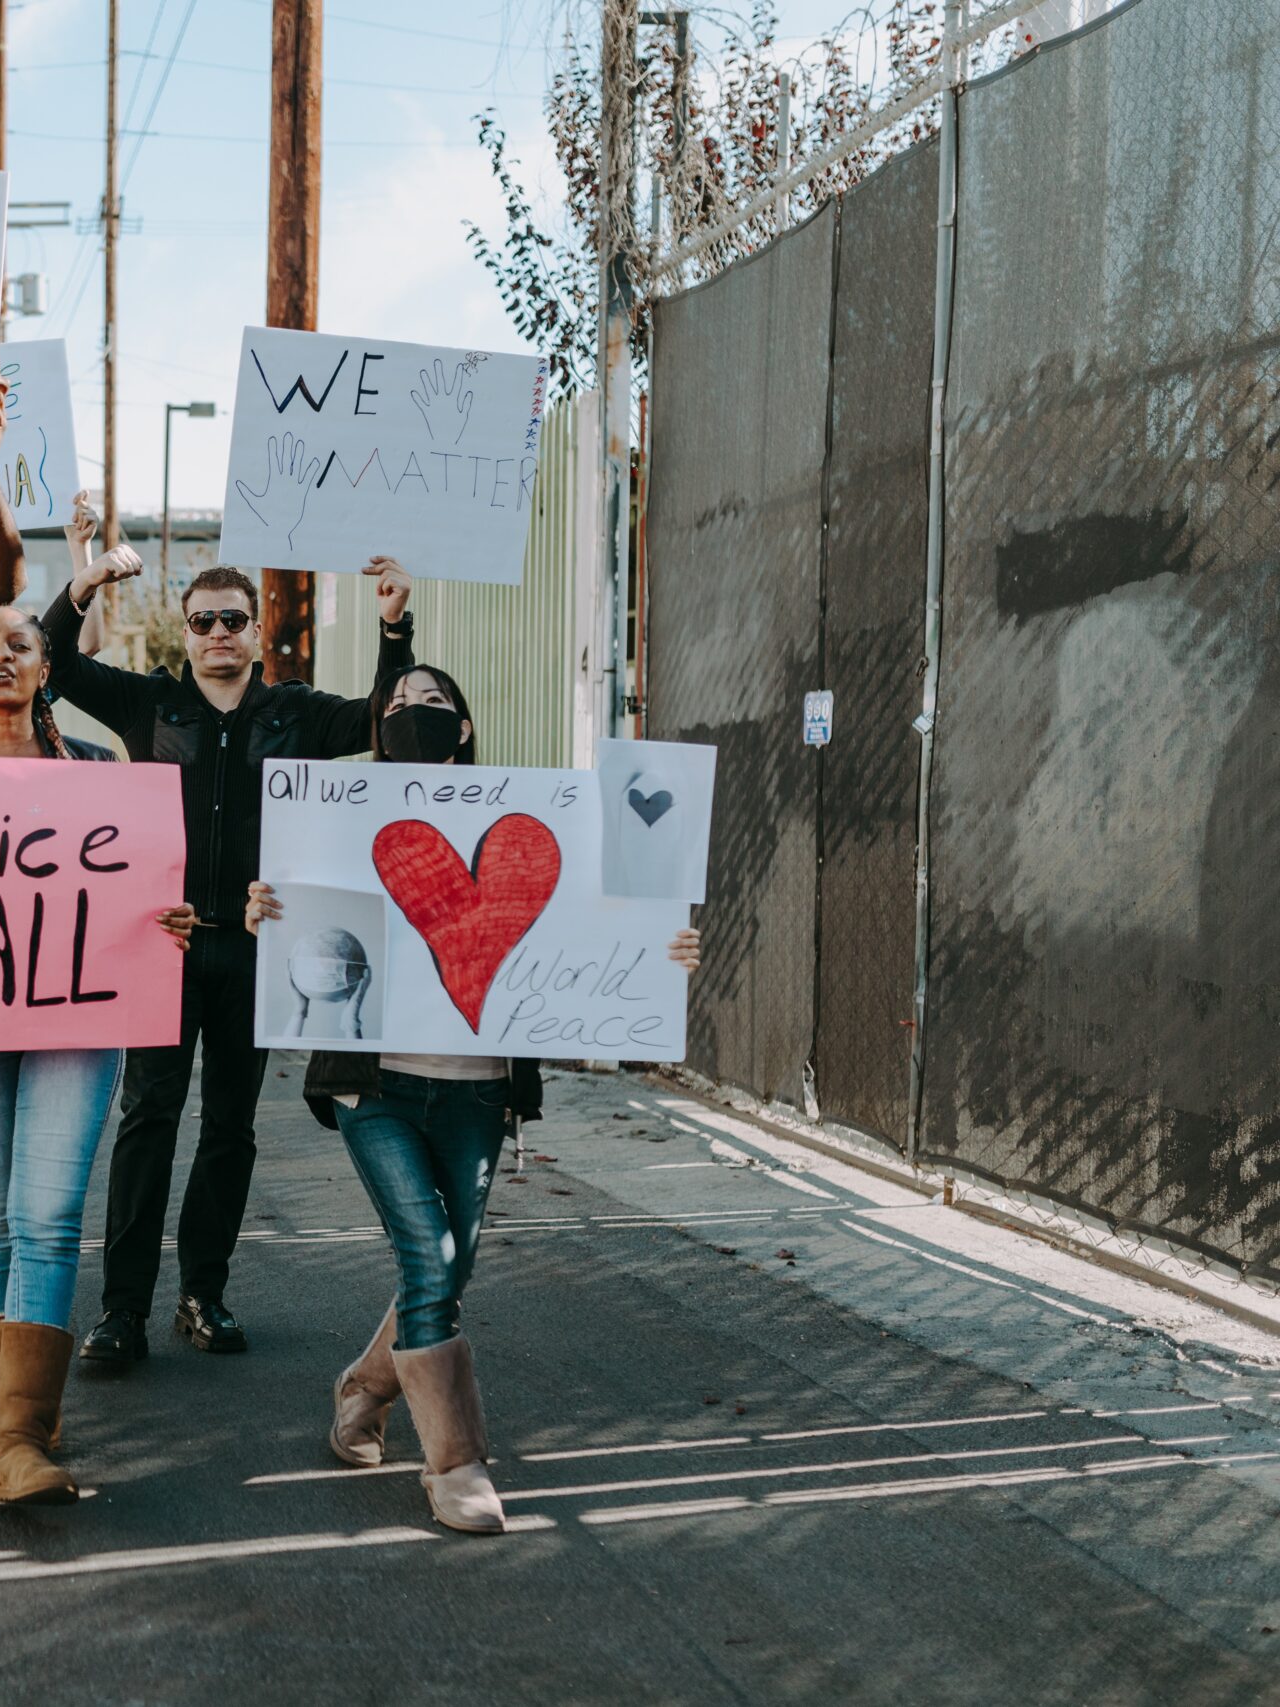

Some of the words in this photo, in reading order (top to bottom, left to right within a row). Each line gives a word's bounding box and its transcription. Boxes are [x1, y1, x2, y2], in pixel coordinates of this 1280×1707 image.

[251, 349, 385, 416] WE
[317, 446, 539, 513] MATTER
[268, 764, 309, 801] all
[320, 779, 370, 806] we
[404, 776, 511, 808] need
[549, 780, 580, 808] is
[497, 941, 650, 1001] World
[498, 992, 672, 1048] Peace
